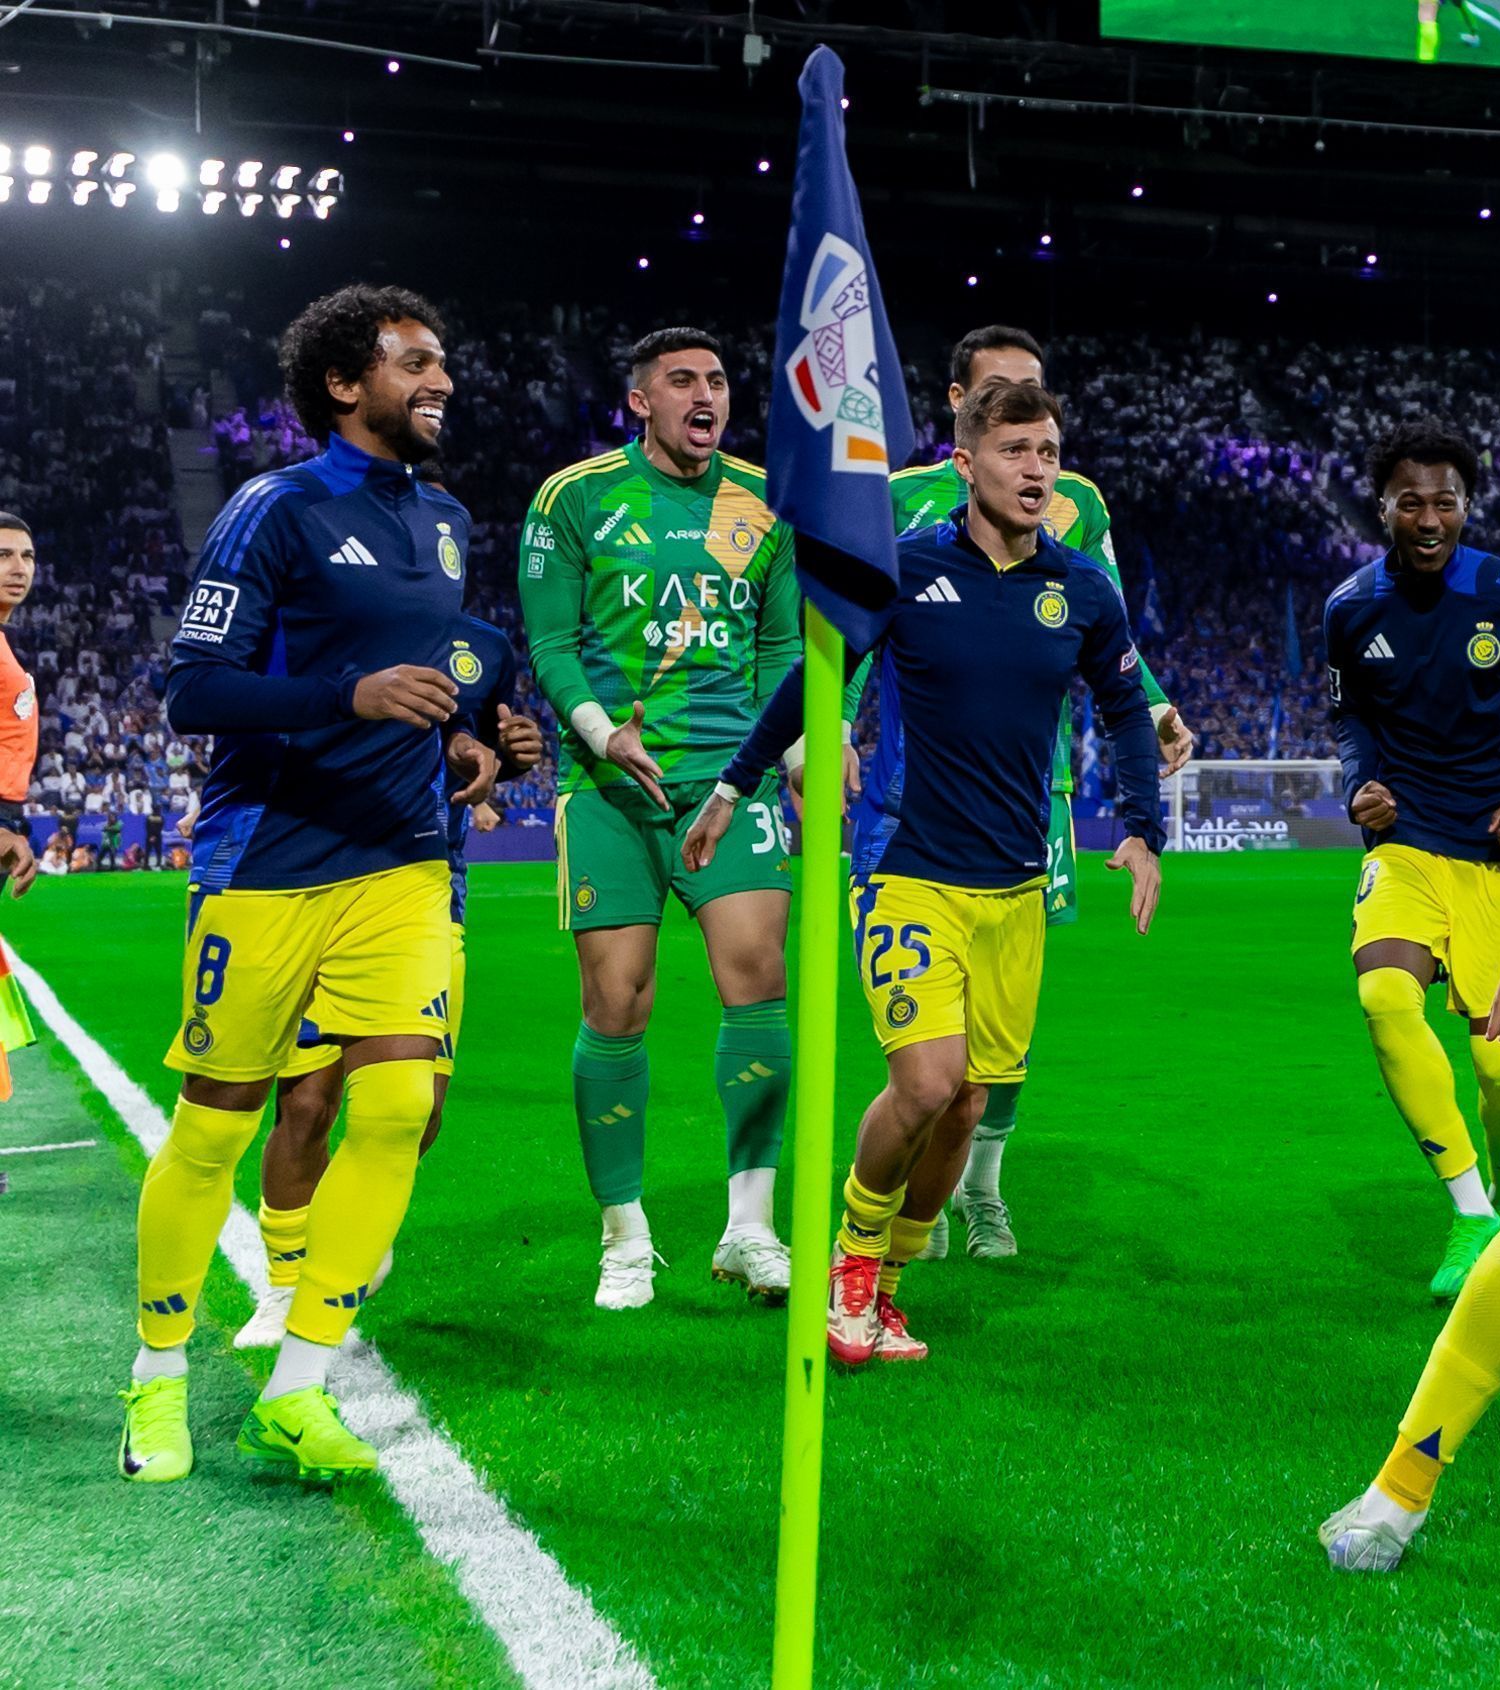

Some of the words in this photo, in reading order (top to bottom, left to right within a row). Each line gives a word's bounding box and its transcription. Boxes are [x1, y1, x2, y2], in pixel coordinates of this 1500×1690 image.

[908, 499, 936, 530] athern
[622, 574, 750, 610] KAFD
[664, 621, 729, 648] SHG
[195, 932, 232, 1007] 8
[868, 923, 932, 990] 25
